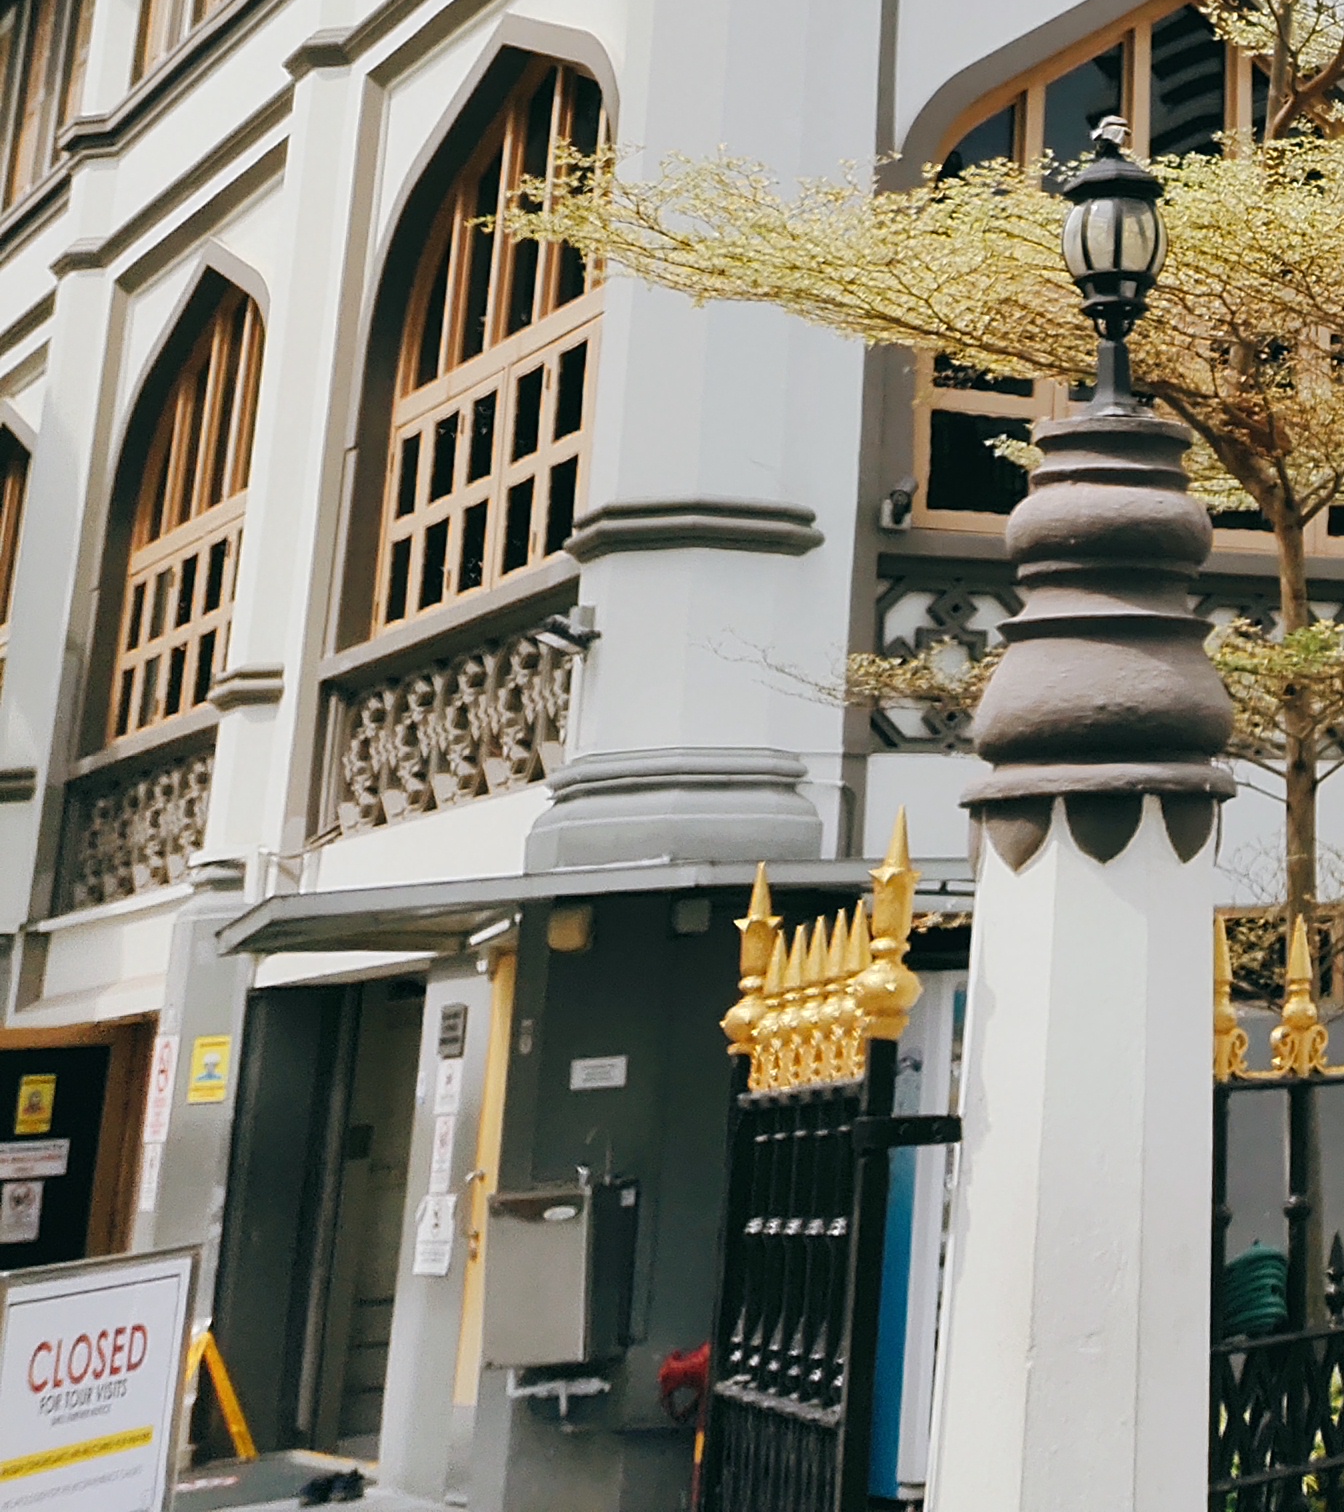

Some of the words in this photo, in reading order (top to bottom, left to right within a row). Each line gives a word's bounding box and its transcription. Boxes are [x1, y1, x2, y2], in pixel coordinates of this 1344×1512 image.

[28, 1323, 148, 1393] CLOSED
[39, 1393, 62, 1416] FOR
[97, 1378, 127, 1402] VISITS
